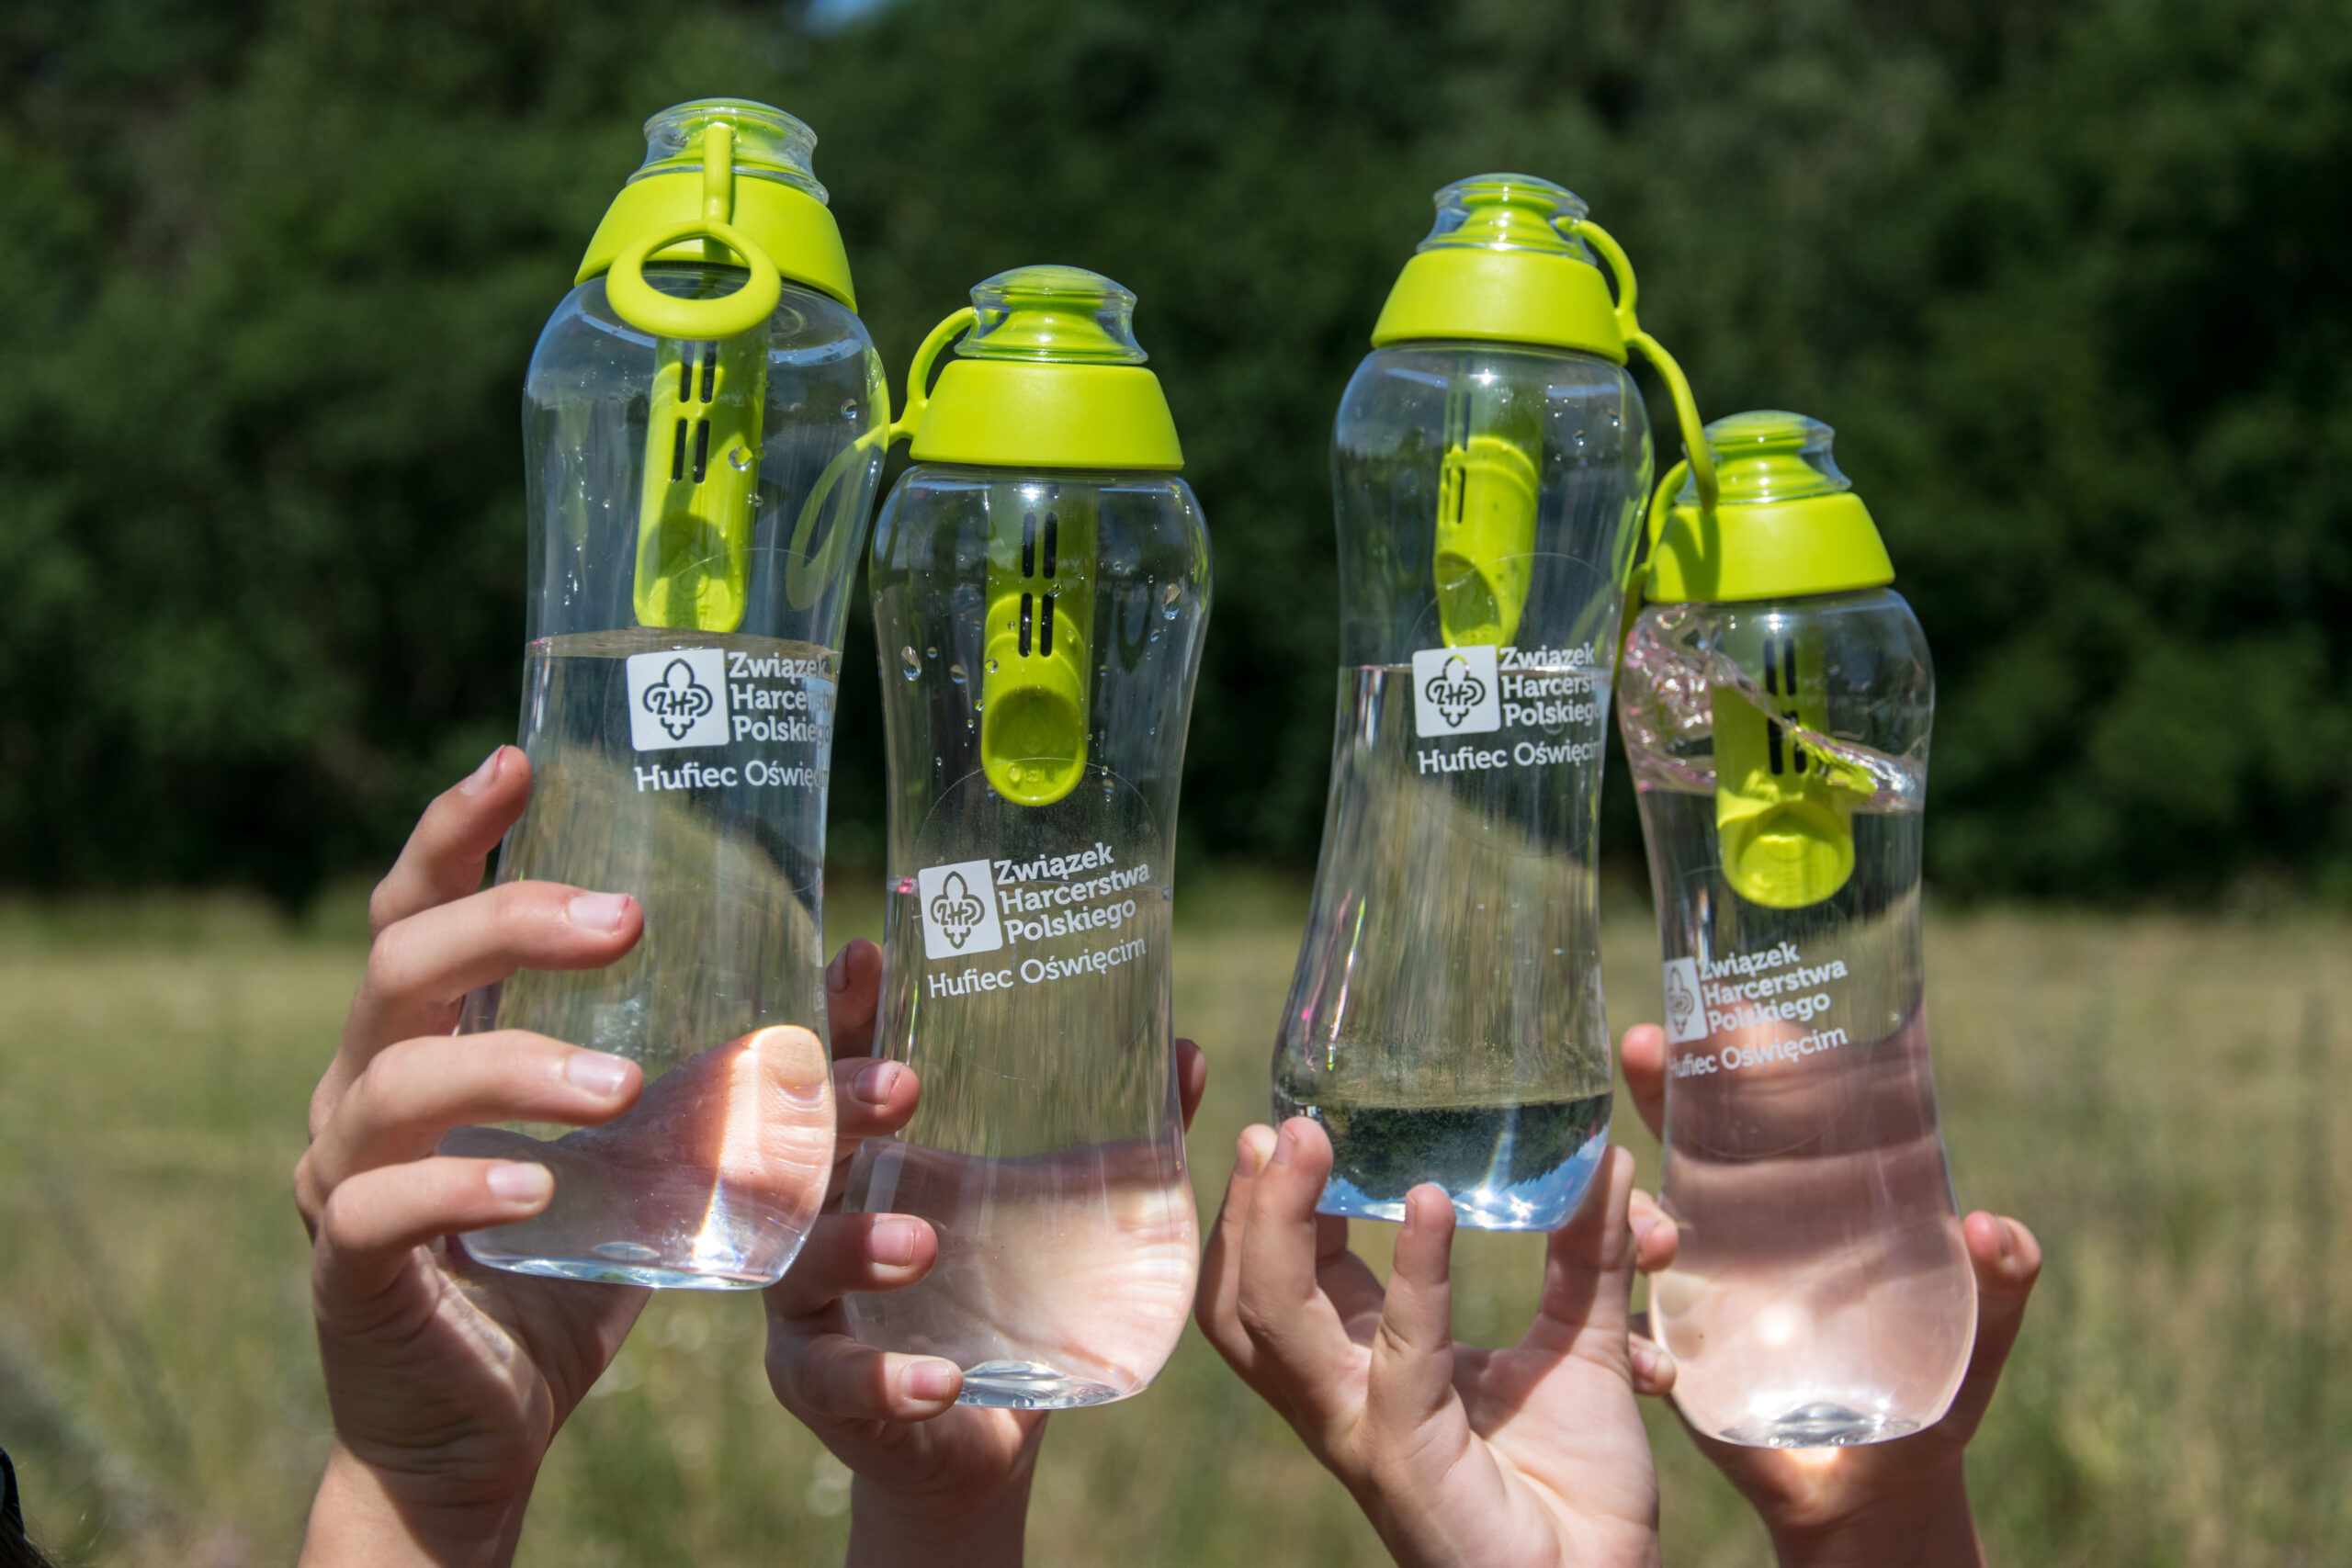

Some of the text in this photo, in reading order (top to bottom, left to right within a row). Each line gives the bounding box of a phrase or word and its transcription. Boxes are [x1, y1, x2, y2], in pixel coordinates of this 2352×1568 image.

[728, 652, 827, 684] Związek
[732, 715, 831, 749] Polskiego
[634, 761, 738, 792] Hufiec
[1417, 746, 1508, 774] Hufiec
[993, 841, 1114, 886] Związek
[998, 863, 1150, 915] Harcerstwa
[1003, 899, 1136, 944] Polskiego
[928, 937, 1148, 998] Hufiec Oświęcim
[1697, 941, 1801, 981] Związek
[1702, 959, 1849, 1008] Harcerstwa
[1707, 993, 1831, 1034] Polskiego
[1721, 1027, 1849, 1070] Oświęcim
